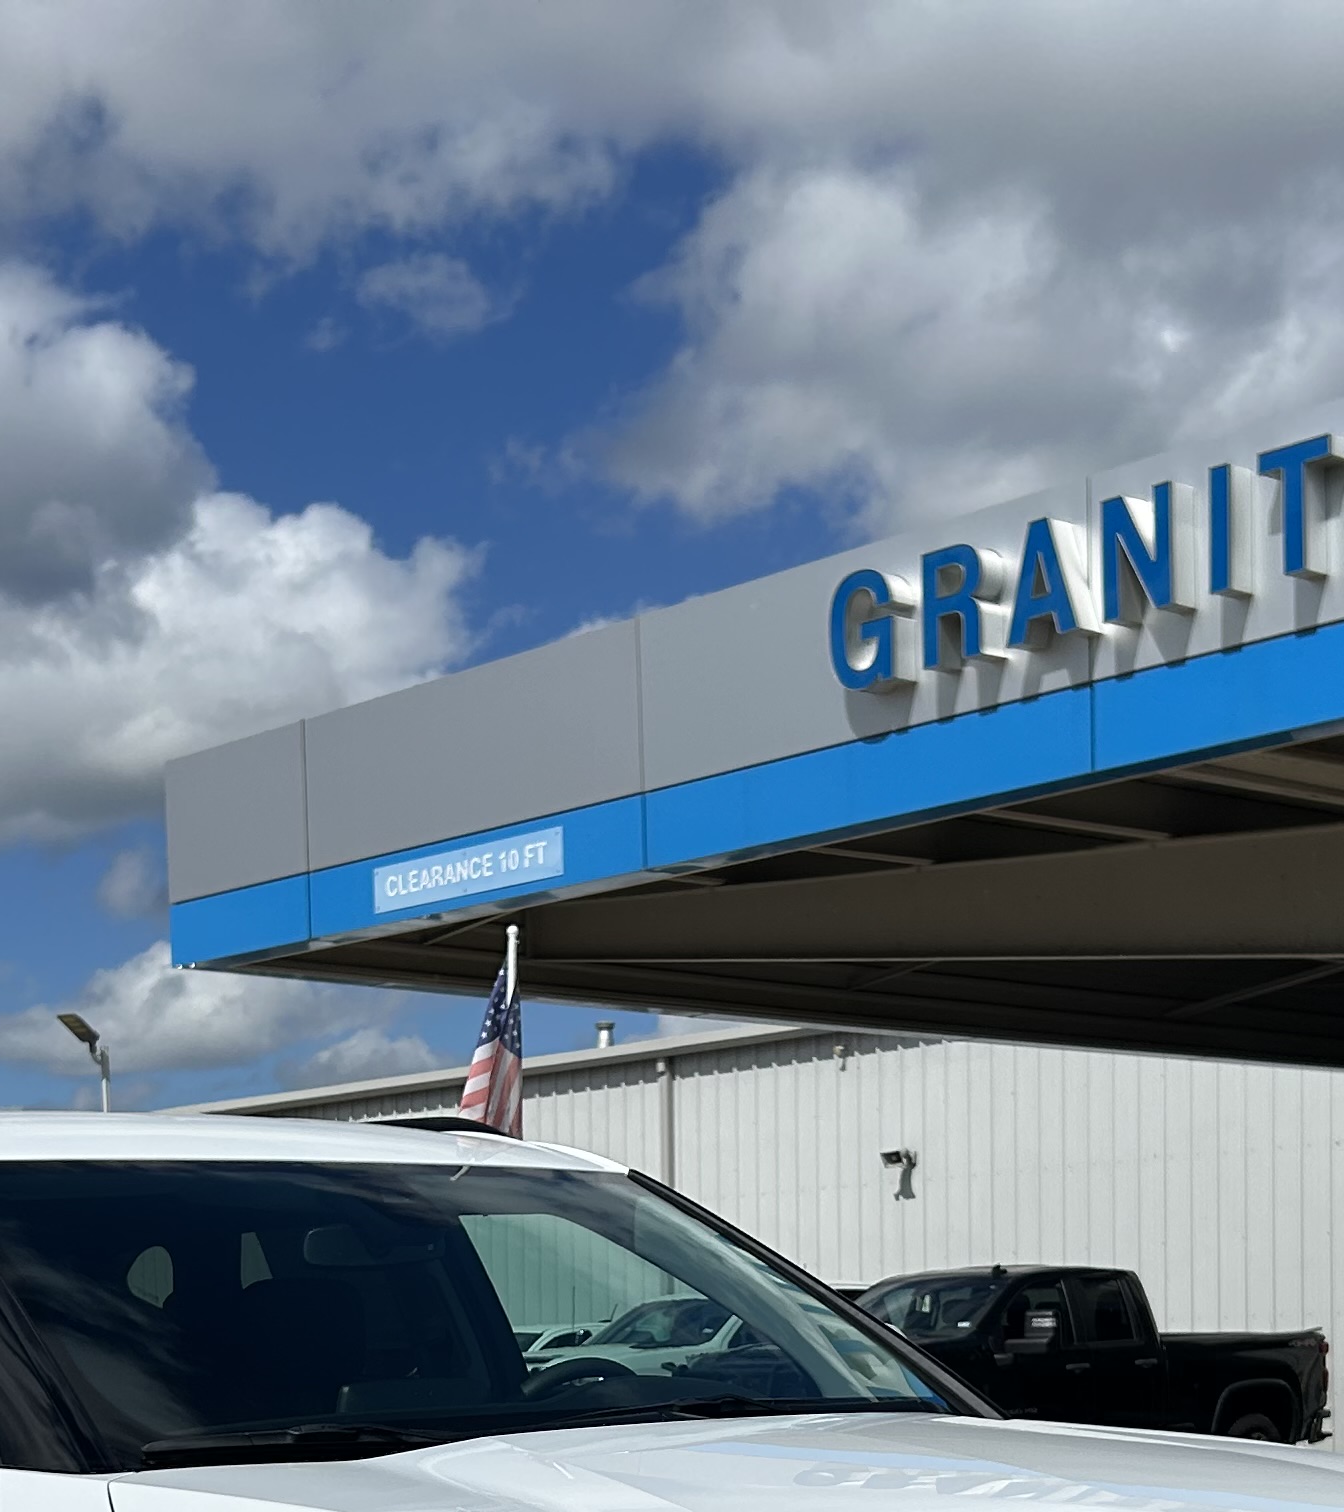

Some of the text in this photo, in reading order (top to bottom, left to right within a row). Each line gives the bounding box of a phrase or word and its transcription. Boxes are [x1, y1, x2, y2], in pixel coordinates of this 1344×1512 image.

[384, 841, 548, 897] CLEARANCE 10 FT
